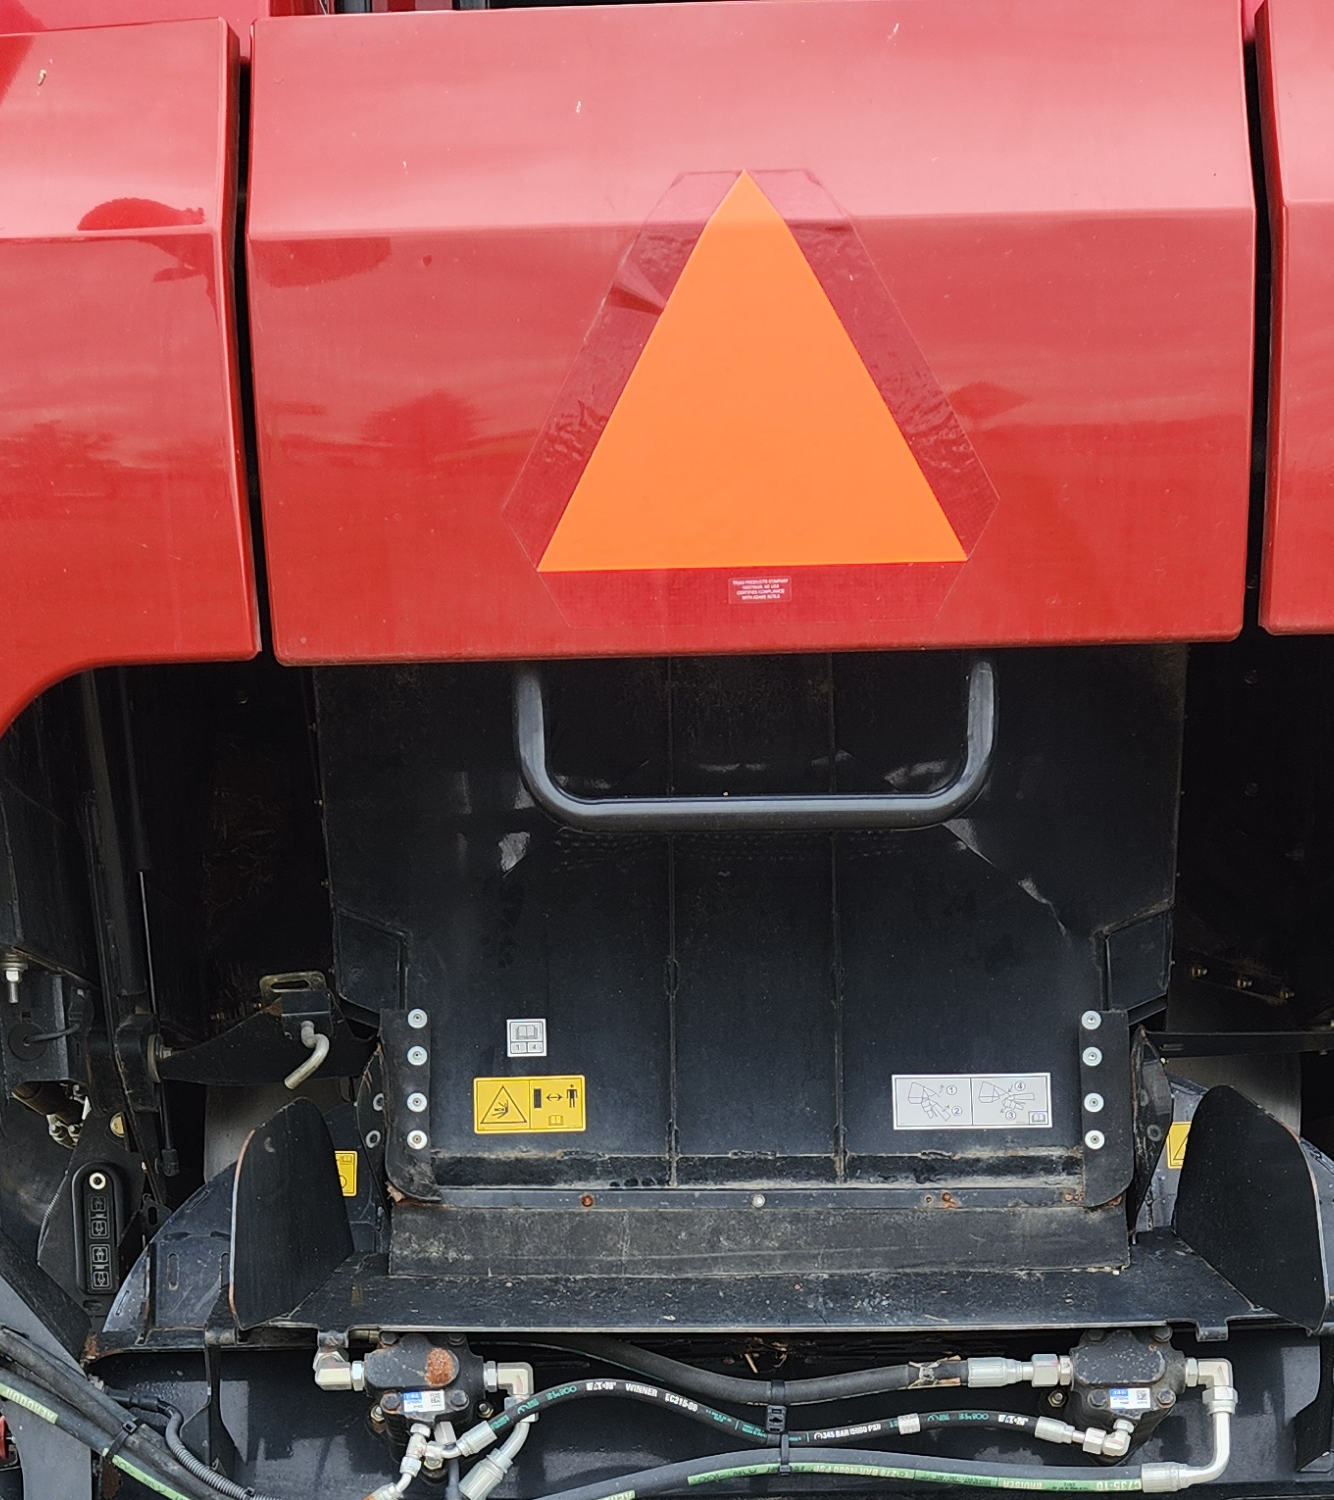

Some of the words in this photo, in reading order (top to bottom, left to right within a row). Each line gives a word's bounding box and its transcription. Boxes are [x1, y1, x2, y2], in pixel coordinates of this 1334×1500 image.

[625, 1382, 658, 1398] WINNER
[1002, 1480, 1043, 1490] BRUISER
[1096, 1479, 1141, 1491] C735-10
